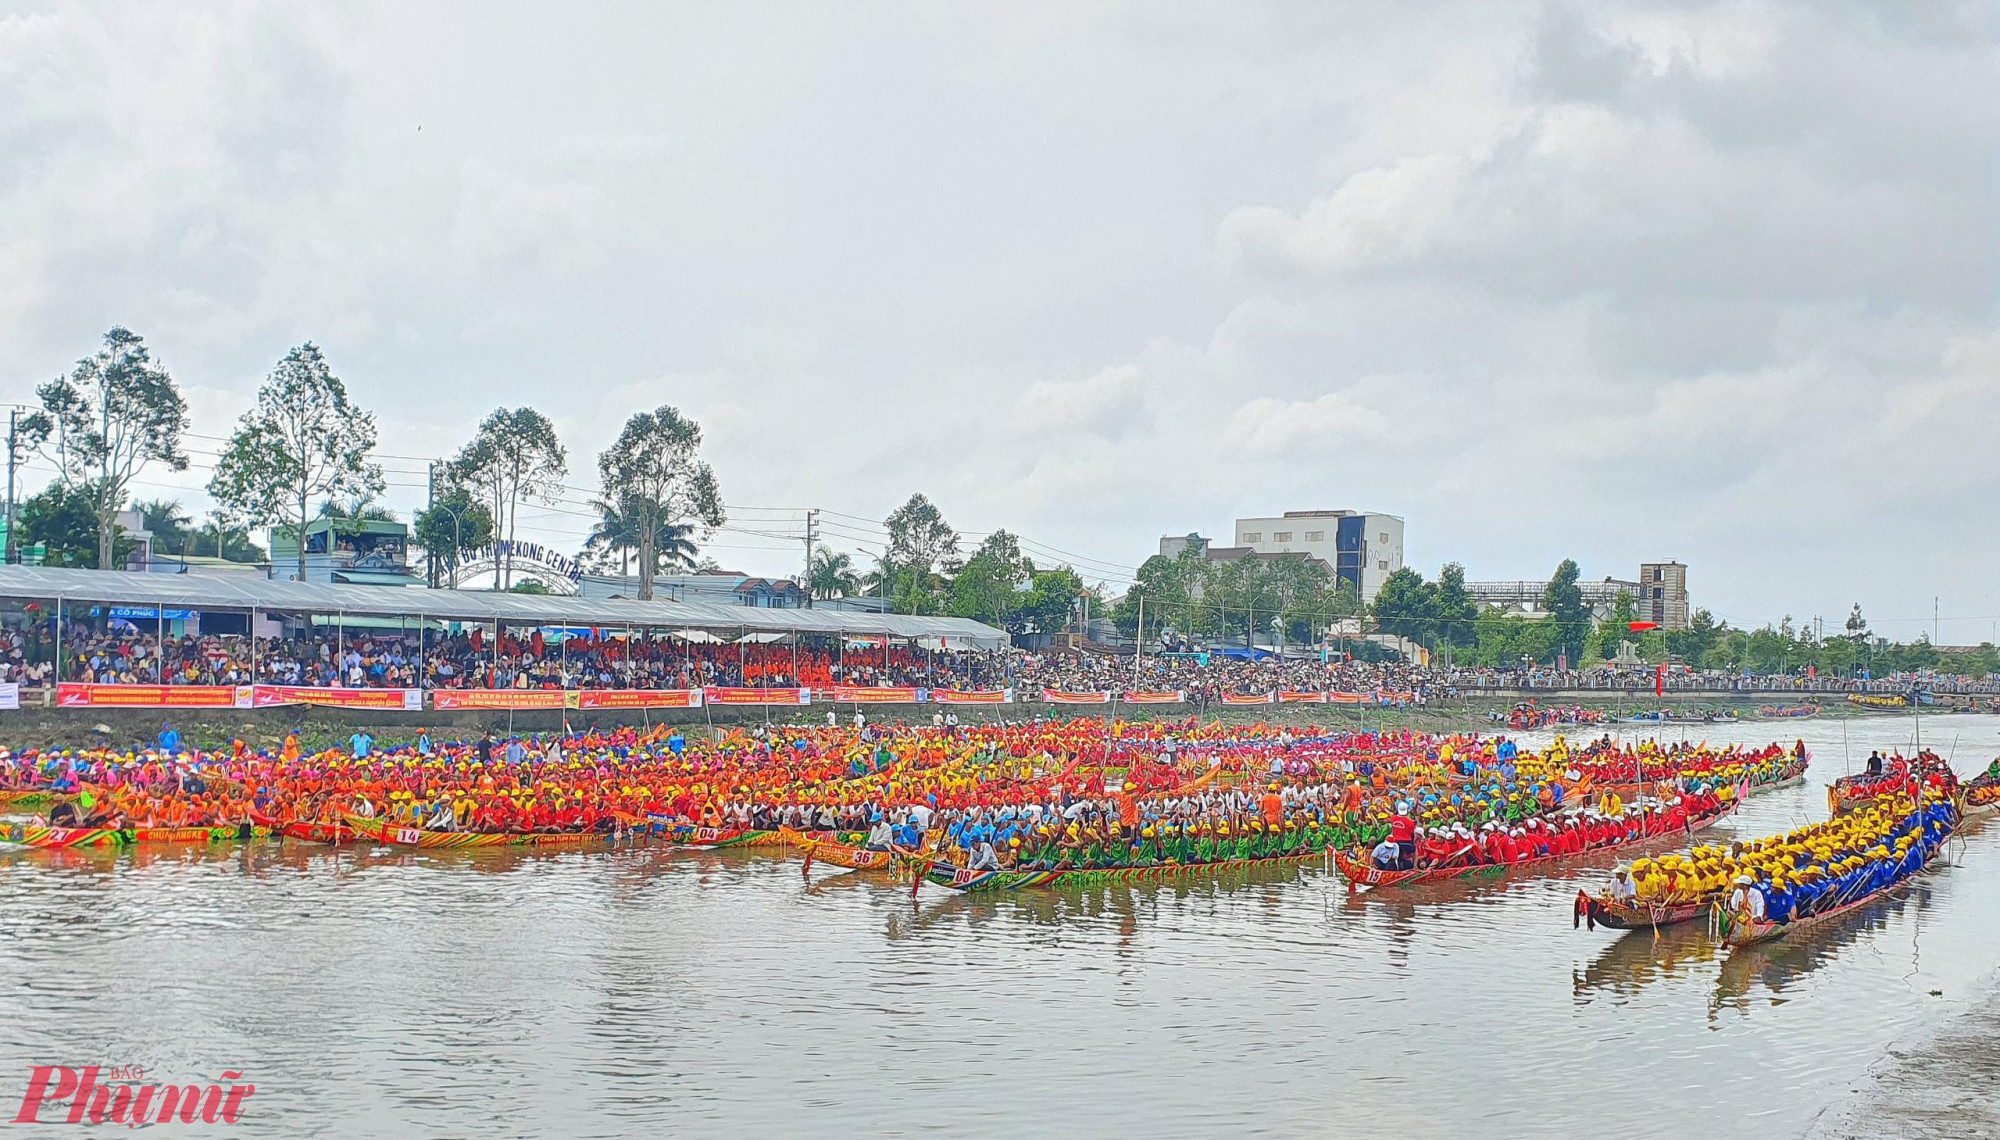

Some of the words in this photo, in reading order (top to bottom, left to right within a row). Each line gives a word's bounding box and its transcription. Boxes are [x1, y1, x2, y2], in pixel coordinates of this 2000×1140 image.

[500, 540, 545, 561] MEKONG
[545, 549, 585, 585] CENTRE
[50, 829, 68, 841] 27
[401, 830, 416, 842] 14
[700, 828, 715, 839] 04
[854, 851, 870, 863] 36
[955, 870, 971, 883] 08
[1369, 871, 1380, 882] 15
